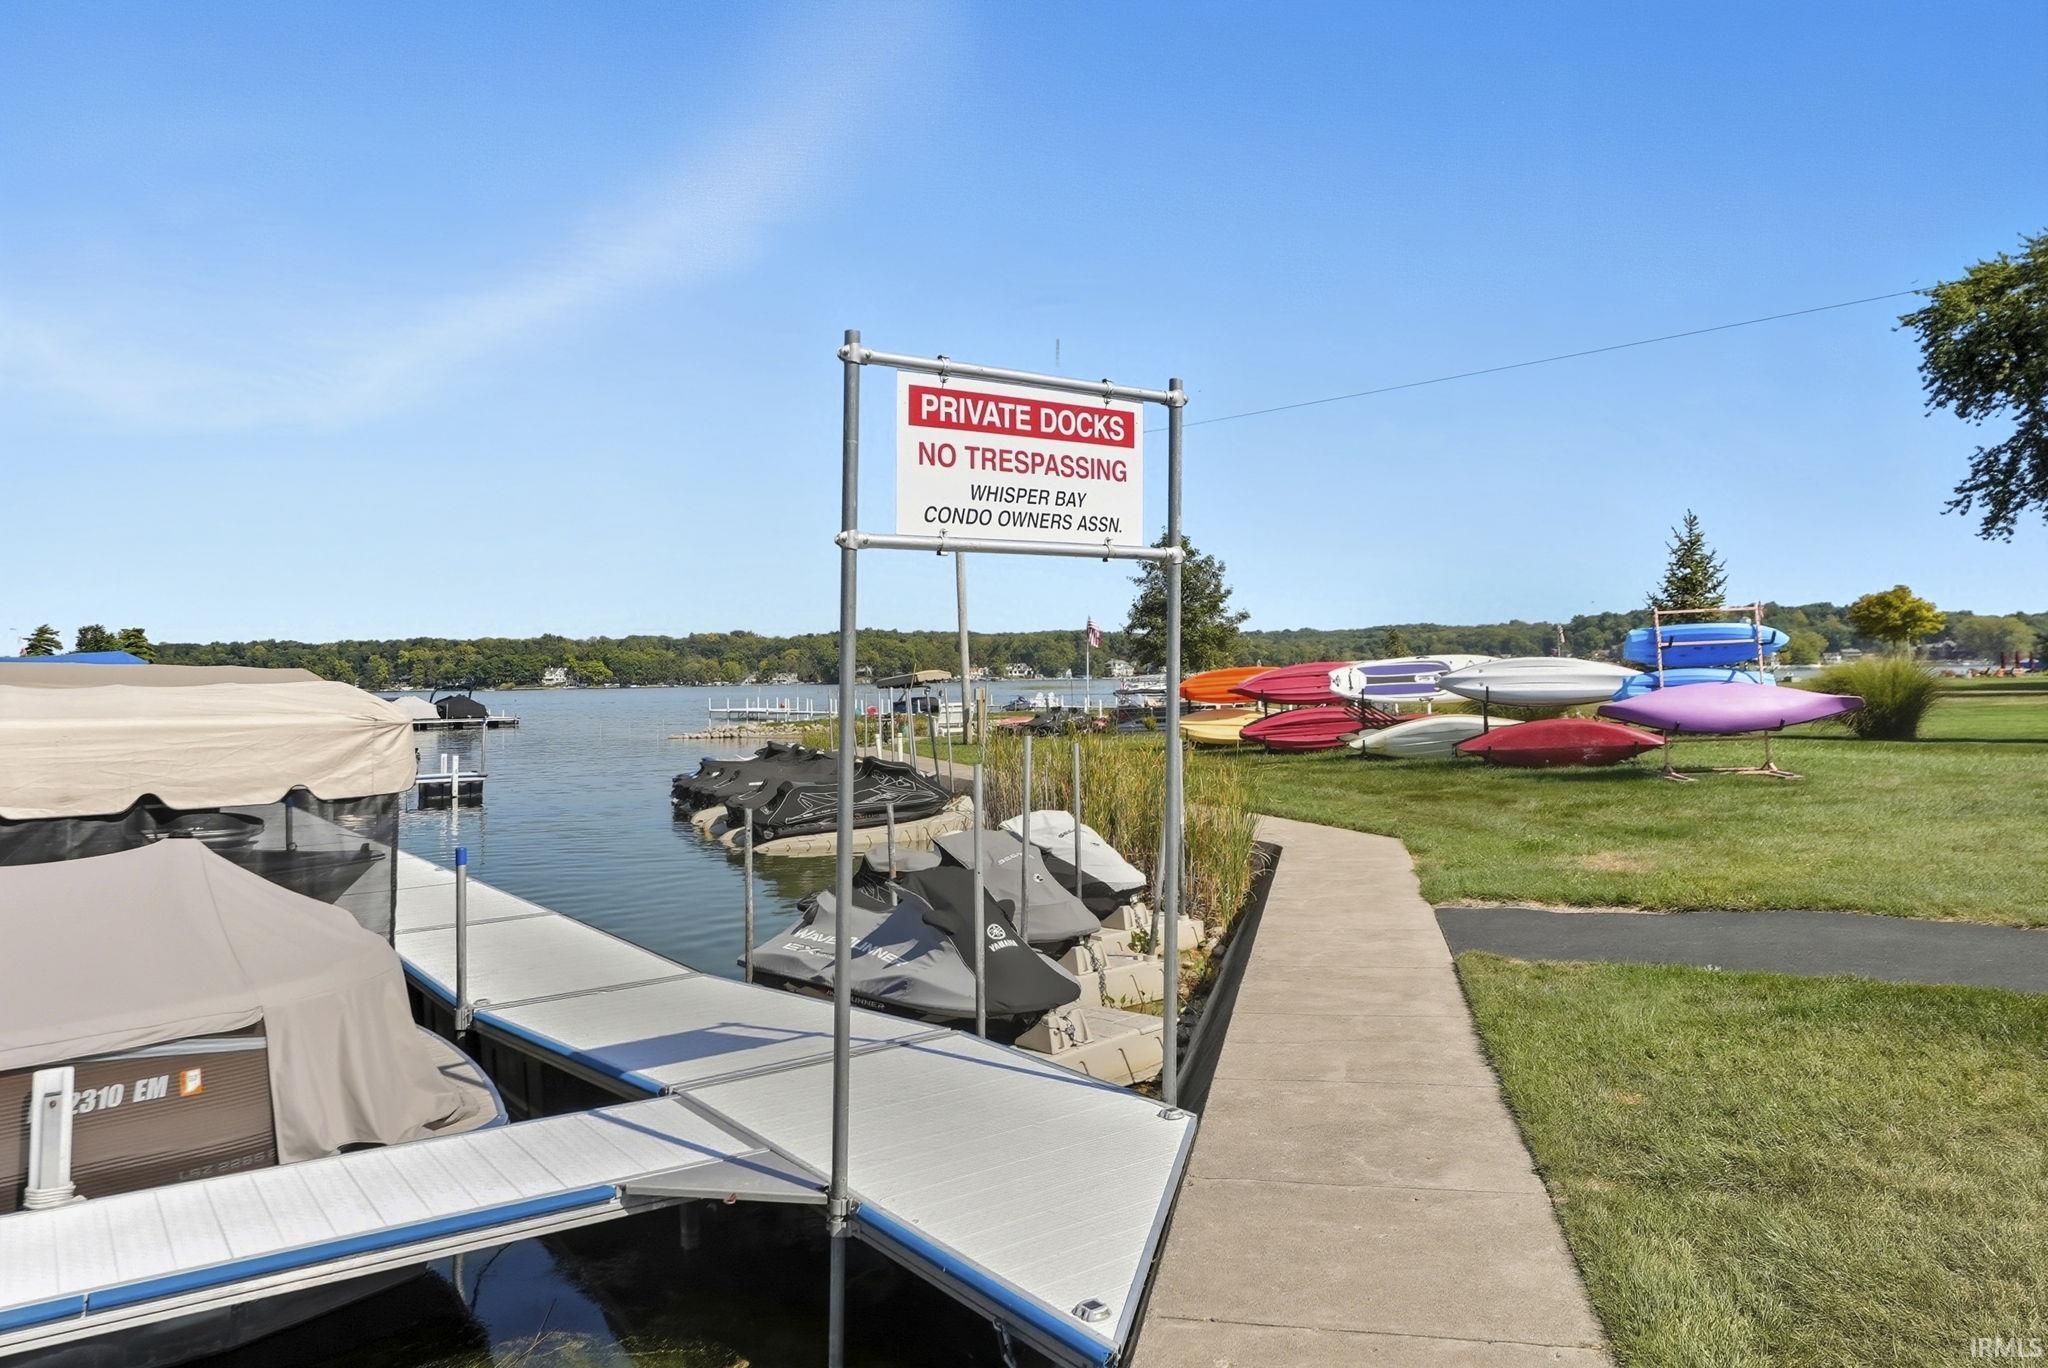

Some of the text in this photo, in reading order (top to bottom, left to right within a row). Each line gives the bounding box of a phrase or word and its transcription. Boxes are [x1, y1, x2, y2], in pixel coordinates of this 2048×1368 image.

[921, 393, 1125, 441] PRIVATE DOCKS
[918, 441, 1128, 483] NO TRESPASSING
[970, 484, 1087, 508] WHISPER BAY
[924, 506, 1123, 533] CONDO OWNERS ASSN.
[988, 939, 1019, 952] YAMAHA
[133, 1075, 169, 1103] EM
